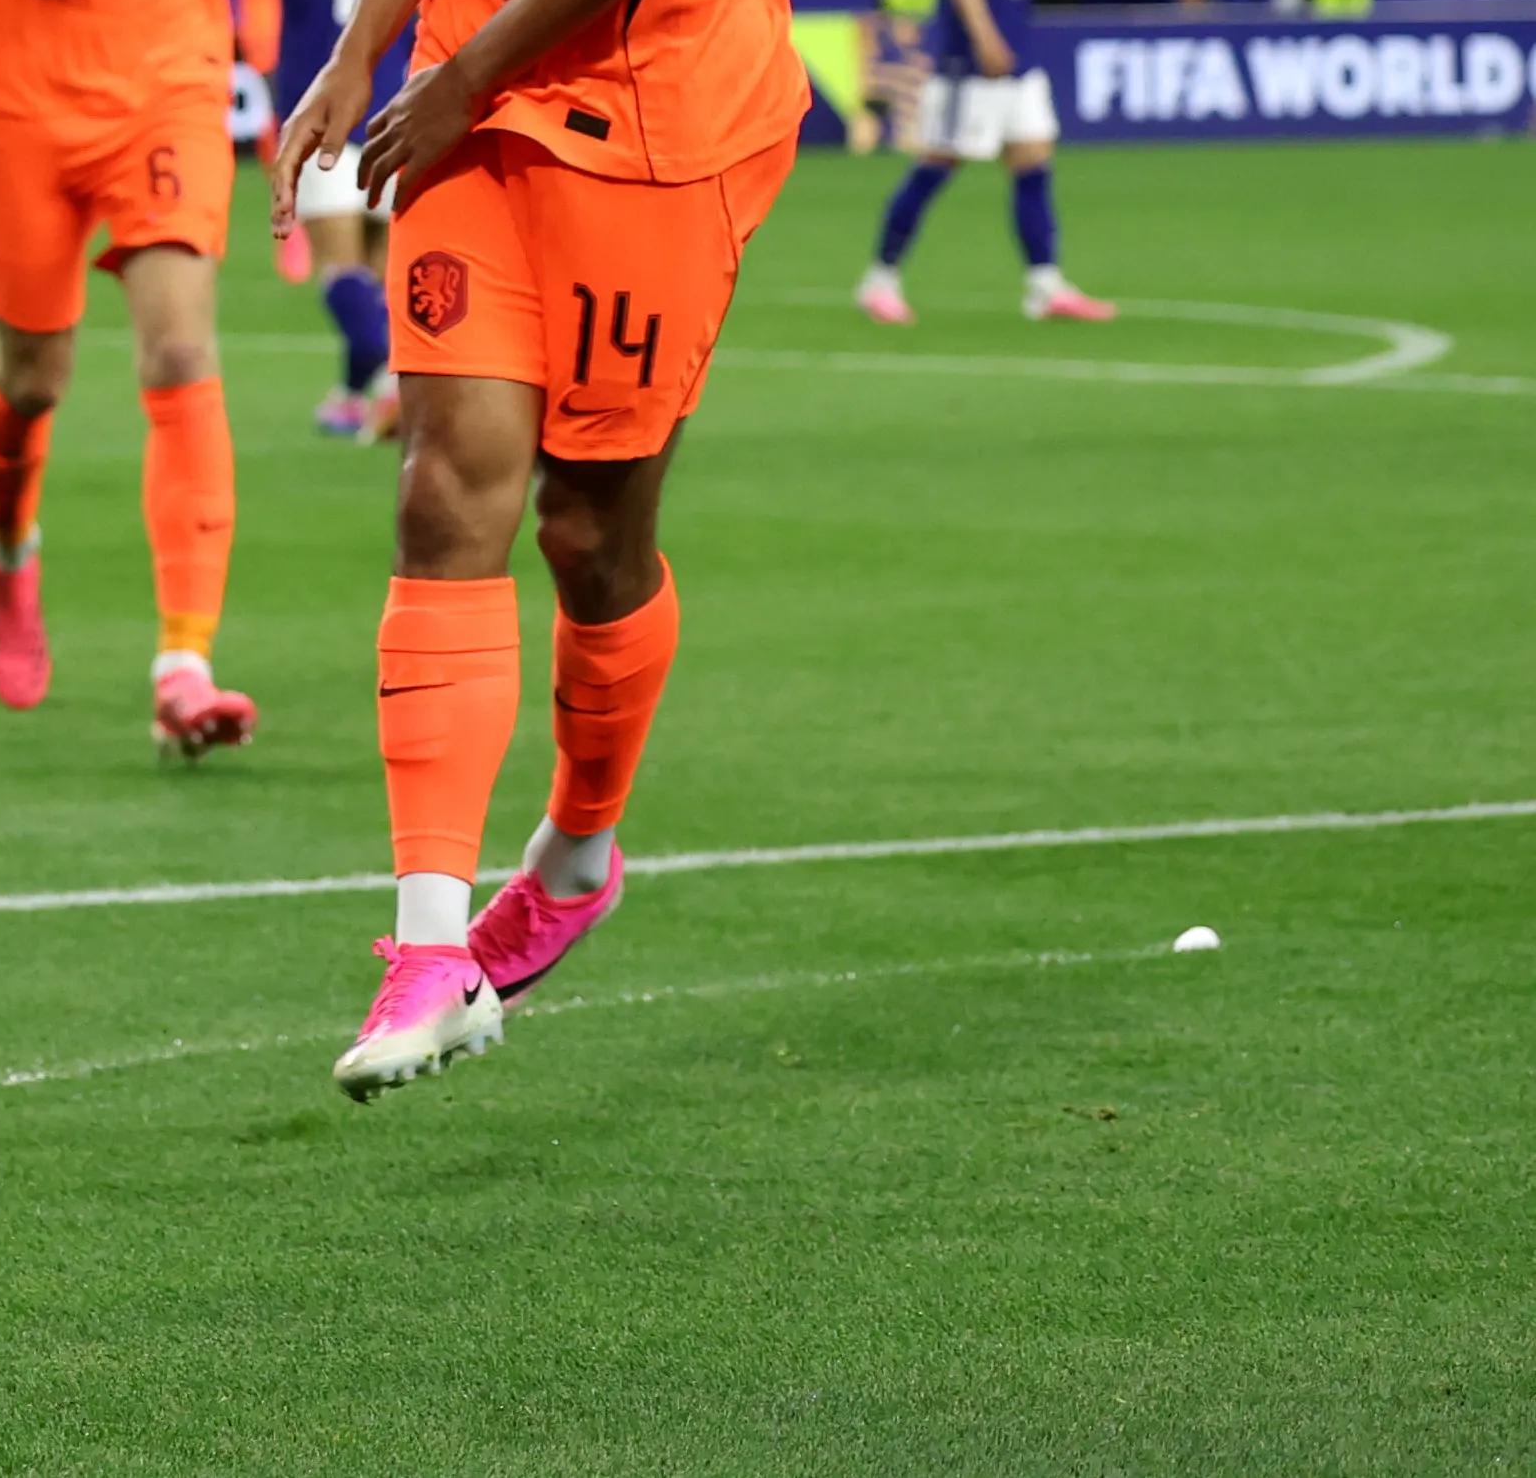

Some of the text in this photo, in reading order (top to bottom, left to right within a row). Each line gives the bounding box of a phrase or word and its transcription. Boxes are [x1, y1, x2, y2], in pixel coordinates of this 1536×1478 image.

[1074, 33, 1524, 121] FIFA WORLD
[147, 146, 181, 199] 6
[574, 282, 662, 388] 14
